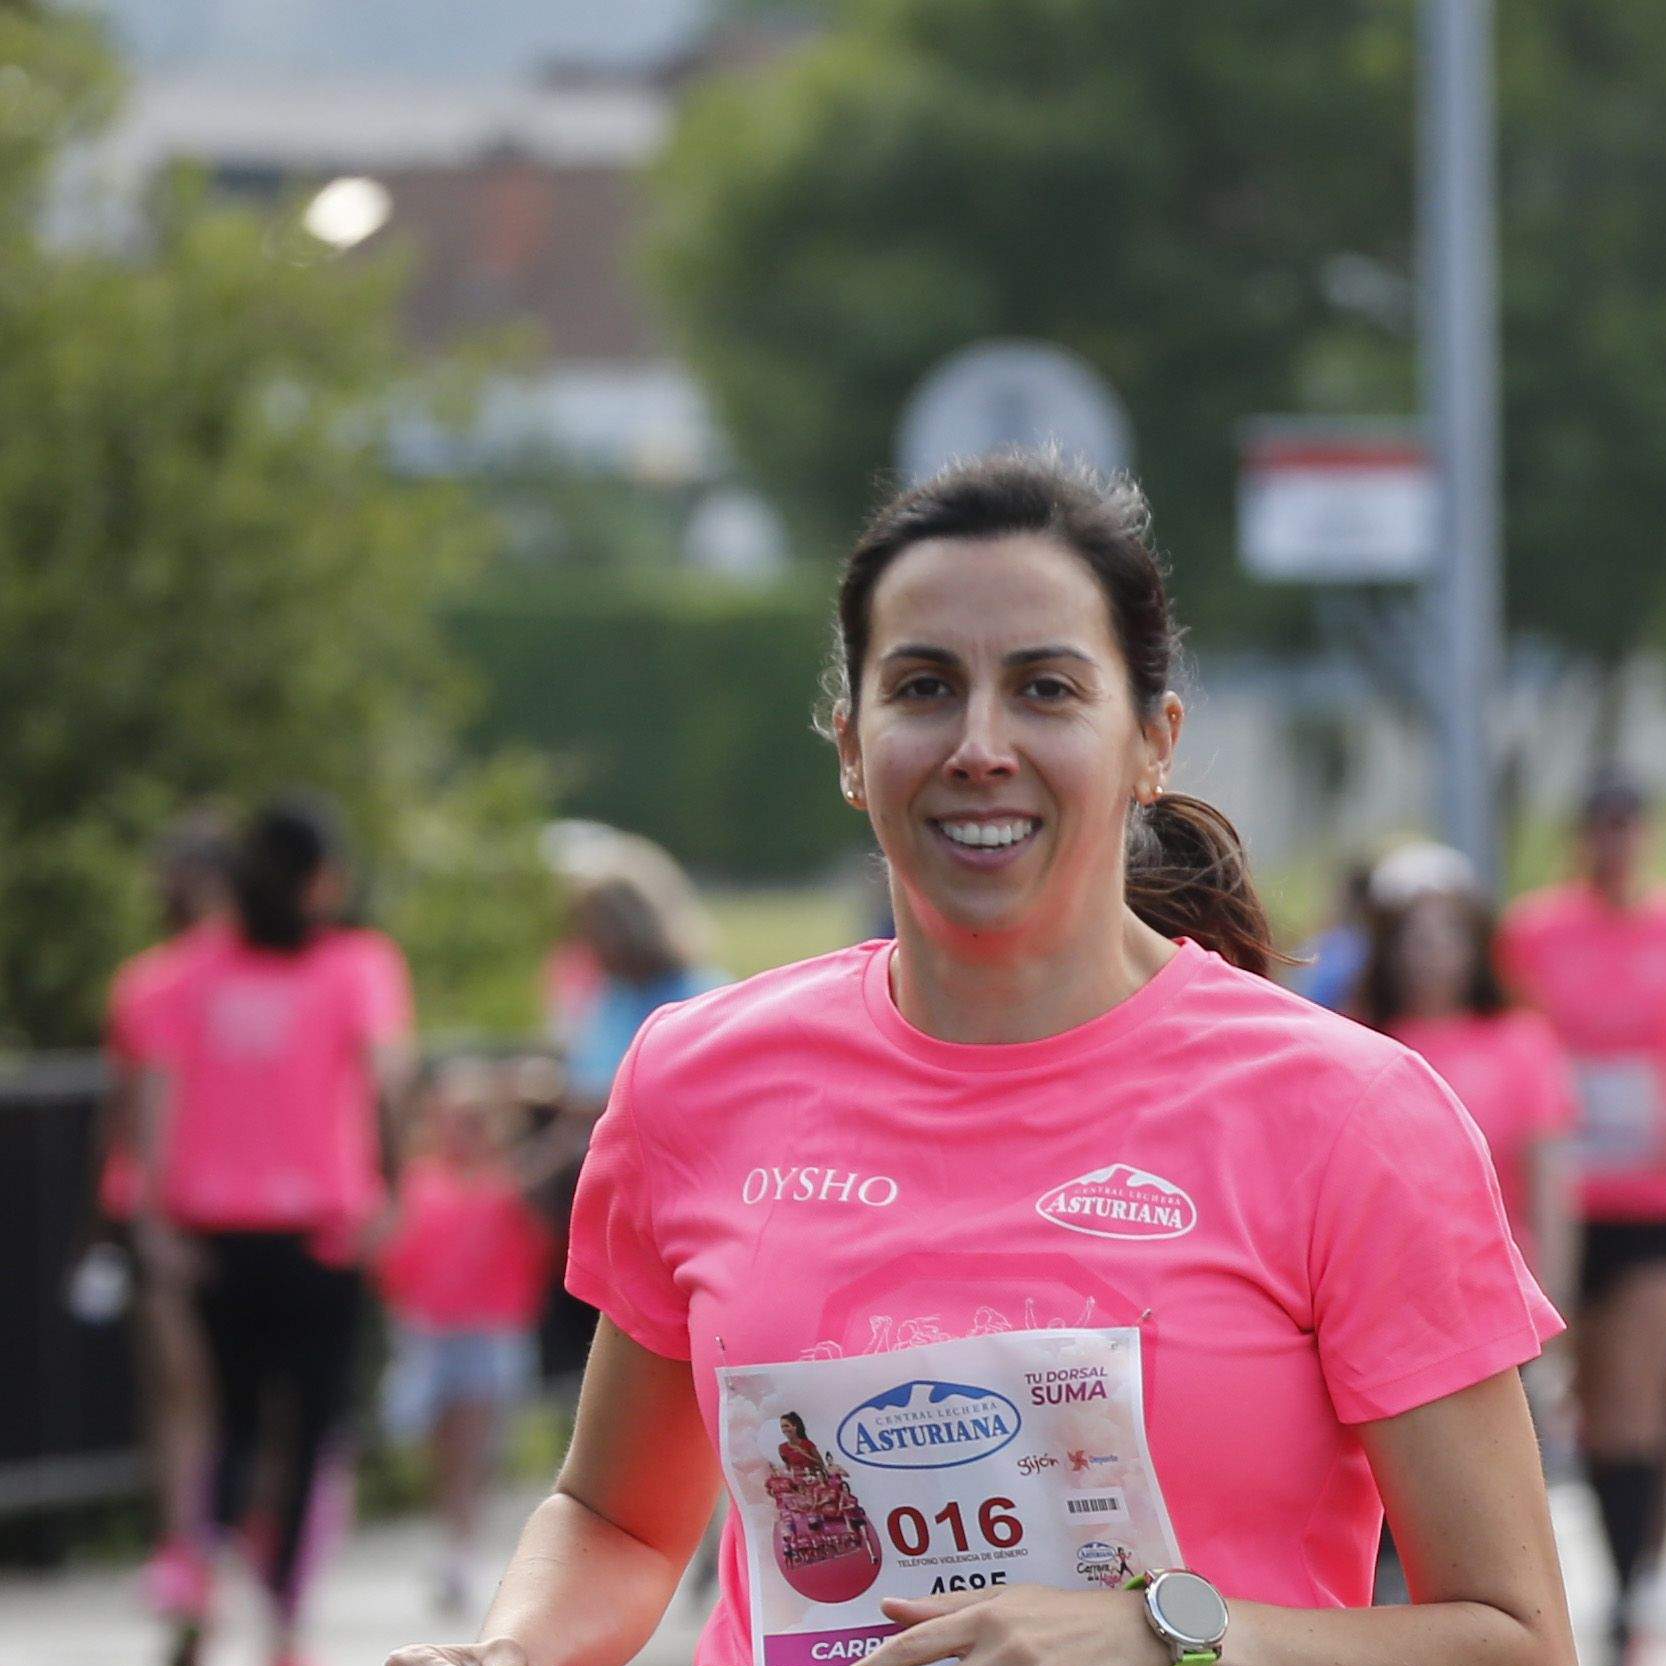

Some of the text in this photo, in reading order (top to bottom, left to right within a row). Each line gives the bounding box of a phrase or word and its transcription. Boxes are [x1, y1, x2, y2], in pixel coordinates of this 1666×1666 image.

[742, 1167, 898, 1206] OYSHO
[1045, 1192, 1183, 1229] ASTURIANA
[1025, 1366, 1108, 1384] TU DORSAL
[1031, 1380, 1107, 1406] SUMA
[875, 1402, 997, 1426] CENTRAL LECHERA
[855, 1414, 1010, 1455] ASTURIANA
[887, 1496, 1024, 1557] 016
[940, 1553, 980, 1565] VIOLENCIA
[982, 1551, 993, 1561] DE
[811, 1637, 886, 1660] CARR
